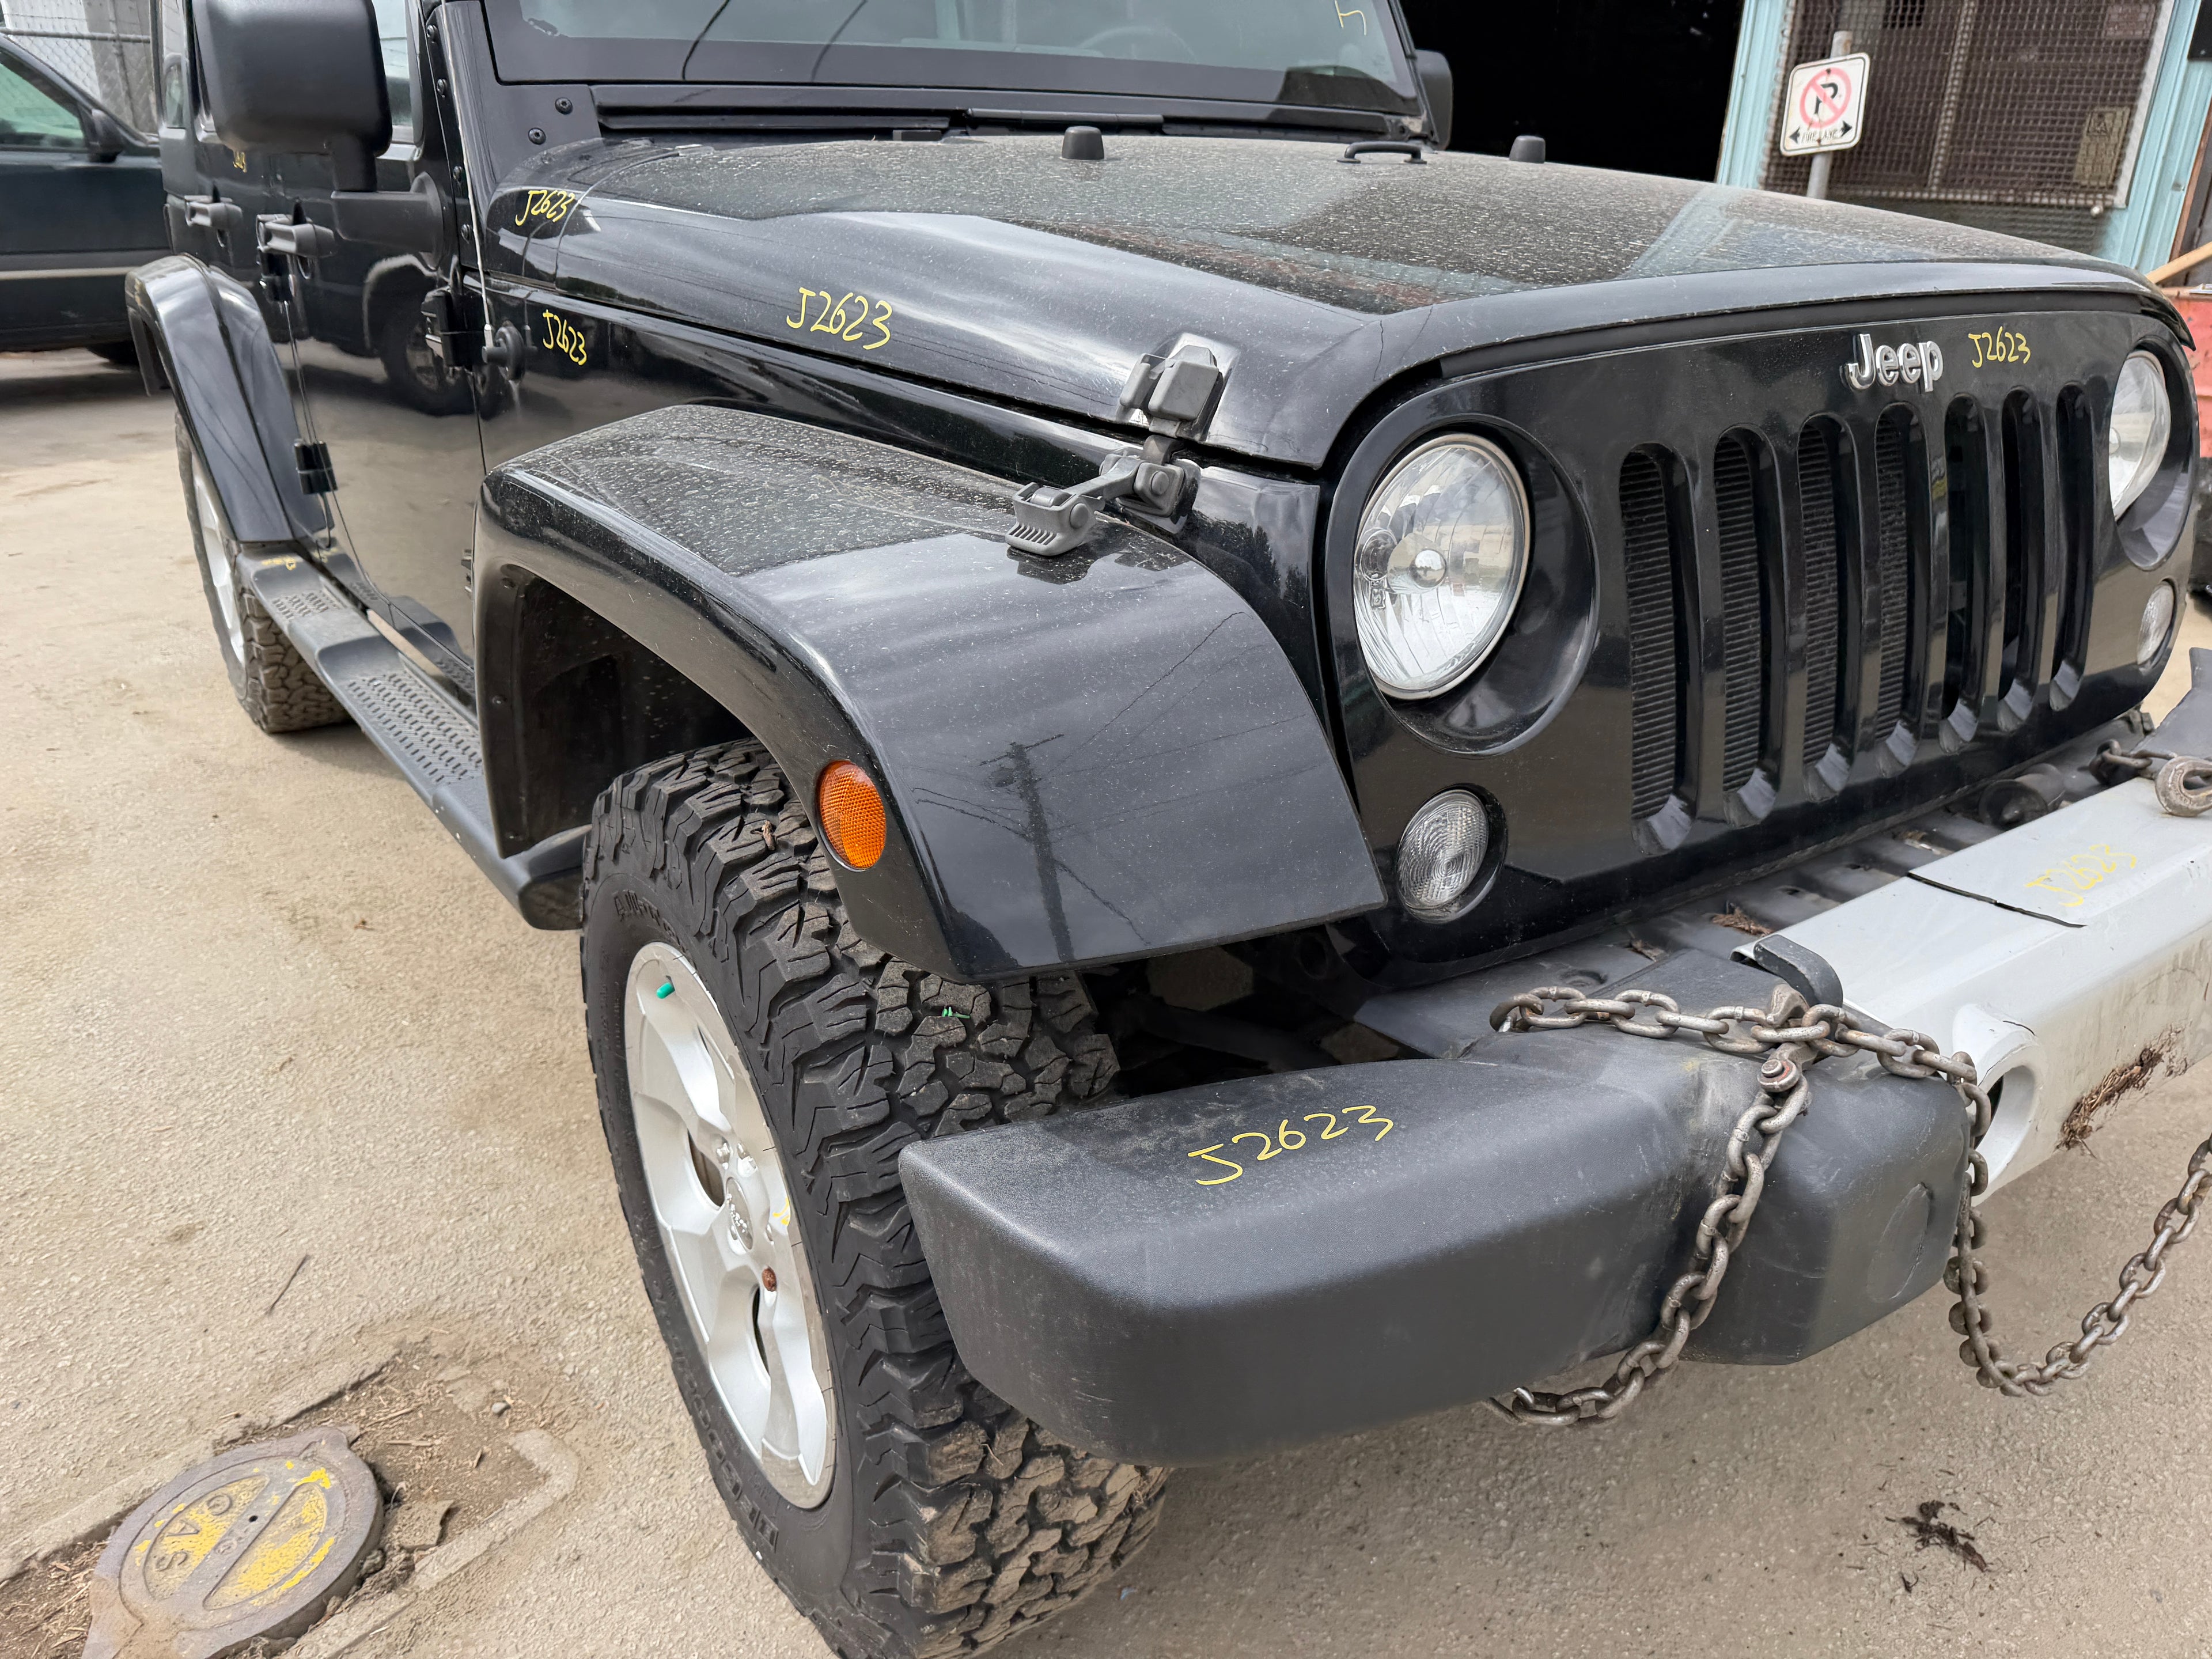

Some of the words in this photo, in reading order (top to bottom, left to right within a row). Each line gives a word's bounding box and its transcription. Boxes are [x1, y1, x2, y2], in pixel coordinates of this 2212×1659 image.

[515, 189, 575, 226] J2623
[543, 309, 587, 366] J2623
[786, 287, 892, 350] J2623
[1968, 326, 2031, 368] J2623
[1845, 334, 1944, 392] Jeep
[2024, 843, 2138, 908] J2623
[1187, 1104, 1393, 1185] J2623
[154, 1492, 232, 1573] GAS
